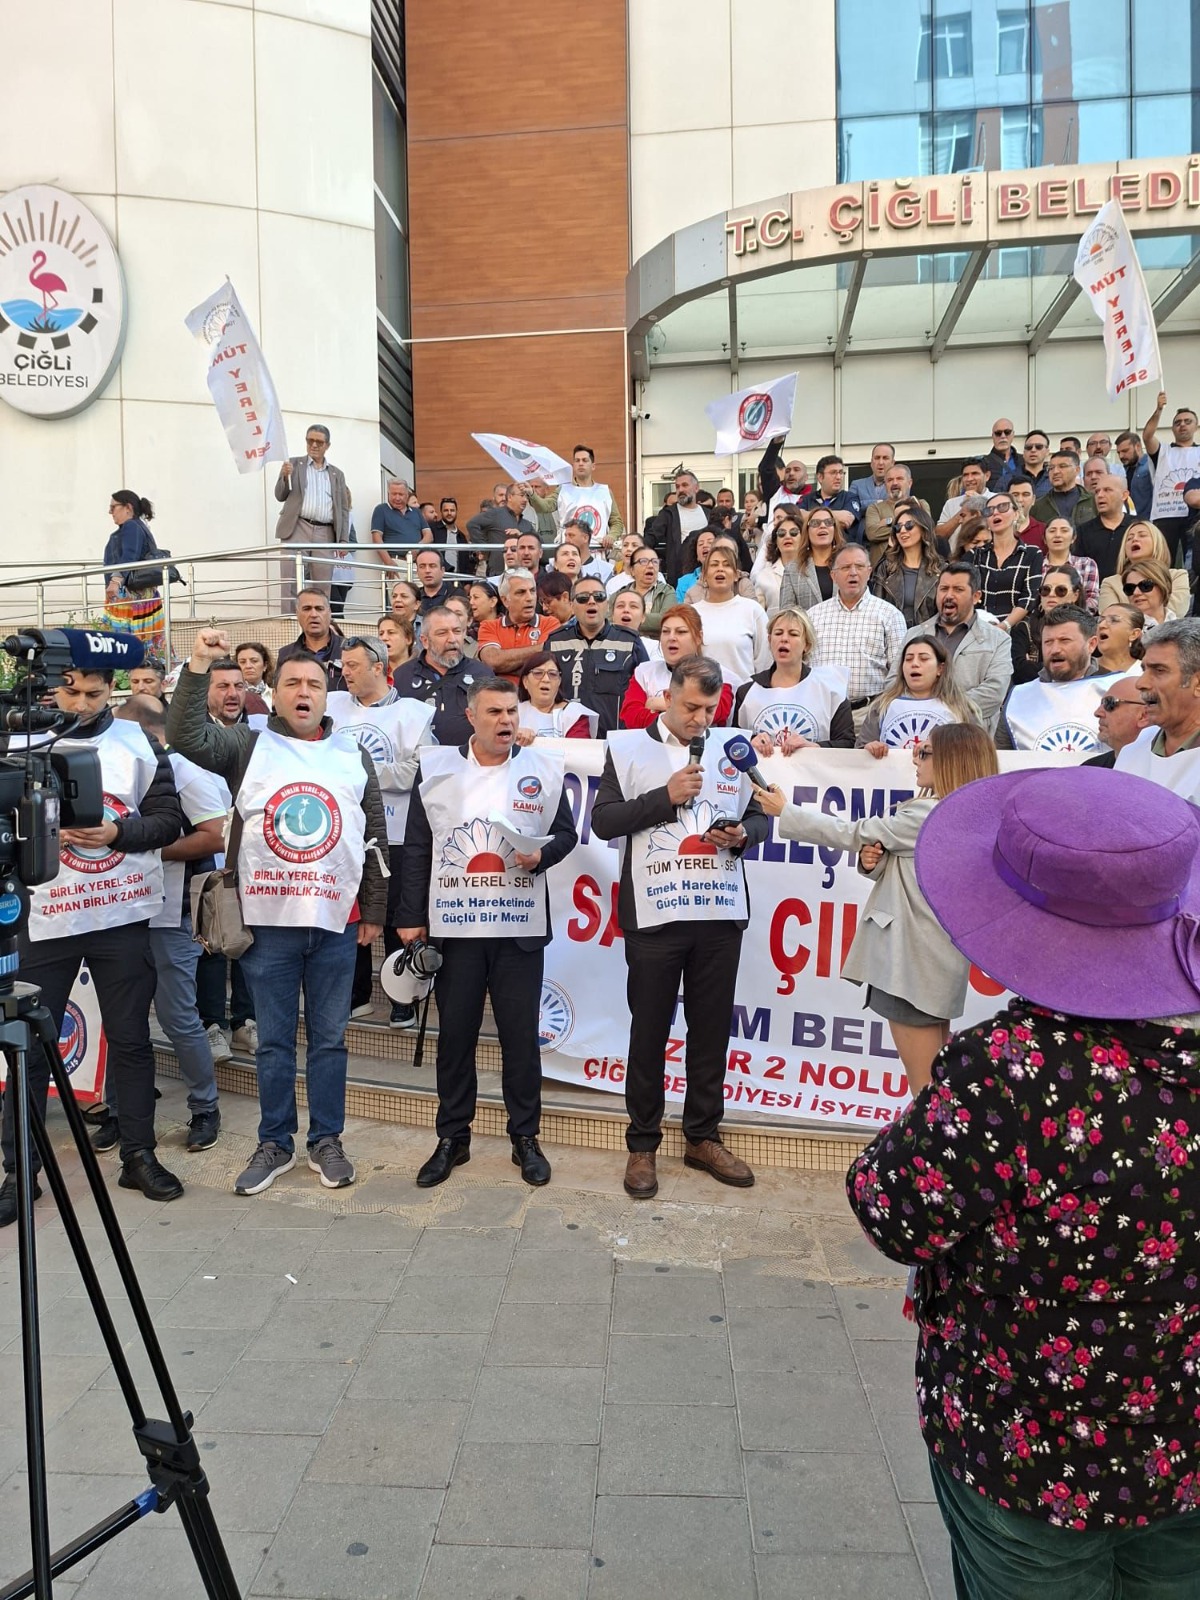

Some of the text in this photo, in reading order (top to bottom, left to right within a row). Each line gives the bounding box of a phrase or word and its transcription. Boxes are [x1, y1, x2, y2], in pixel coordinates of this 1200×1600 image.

[725, 211, 803, 256] T.C.
[828, 175, 973, 244] ÇİĞLİ
[14, 350, 72, 371] ÇİĞLİ
[86, 632, 129, 654] bir tv
[646, 859, 671, 876] TÜM
[674, 858, 718, 871] YEREL
[50, 872, 144, 899] BİRLİK YEREL-SEN
[254, 869, 337, 885] BİRLİK YEREL-SEN
[438, 875, 459, 888] TÜM
[462, 875, 506, 888] YEREL
[514, 877, 535, 888] SEN
[245, 886, 278, 896] ZAMAN
[280, 883, 312, 896] BİRLİK
[647, 882, 677, 898] Emek
[42, 900, 81, 916] ZAMAN
[83, 893, 119, 909] BİRLİK
[436, 897, 535, 909] Emek Hareketinde
[656, 894, 690, 911] Güçlü
[694, 895, 711, 906] Bir
[442, 912, 529, 926] Güçlü Bir Mevzi
[763, 1055, 786, 1080] 2
[799, 1060, 909, 1098] NOLU
